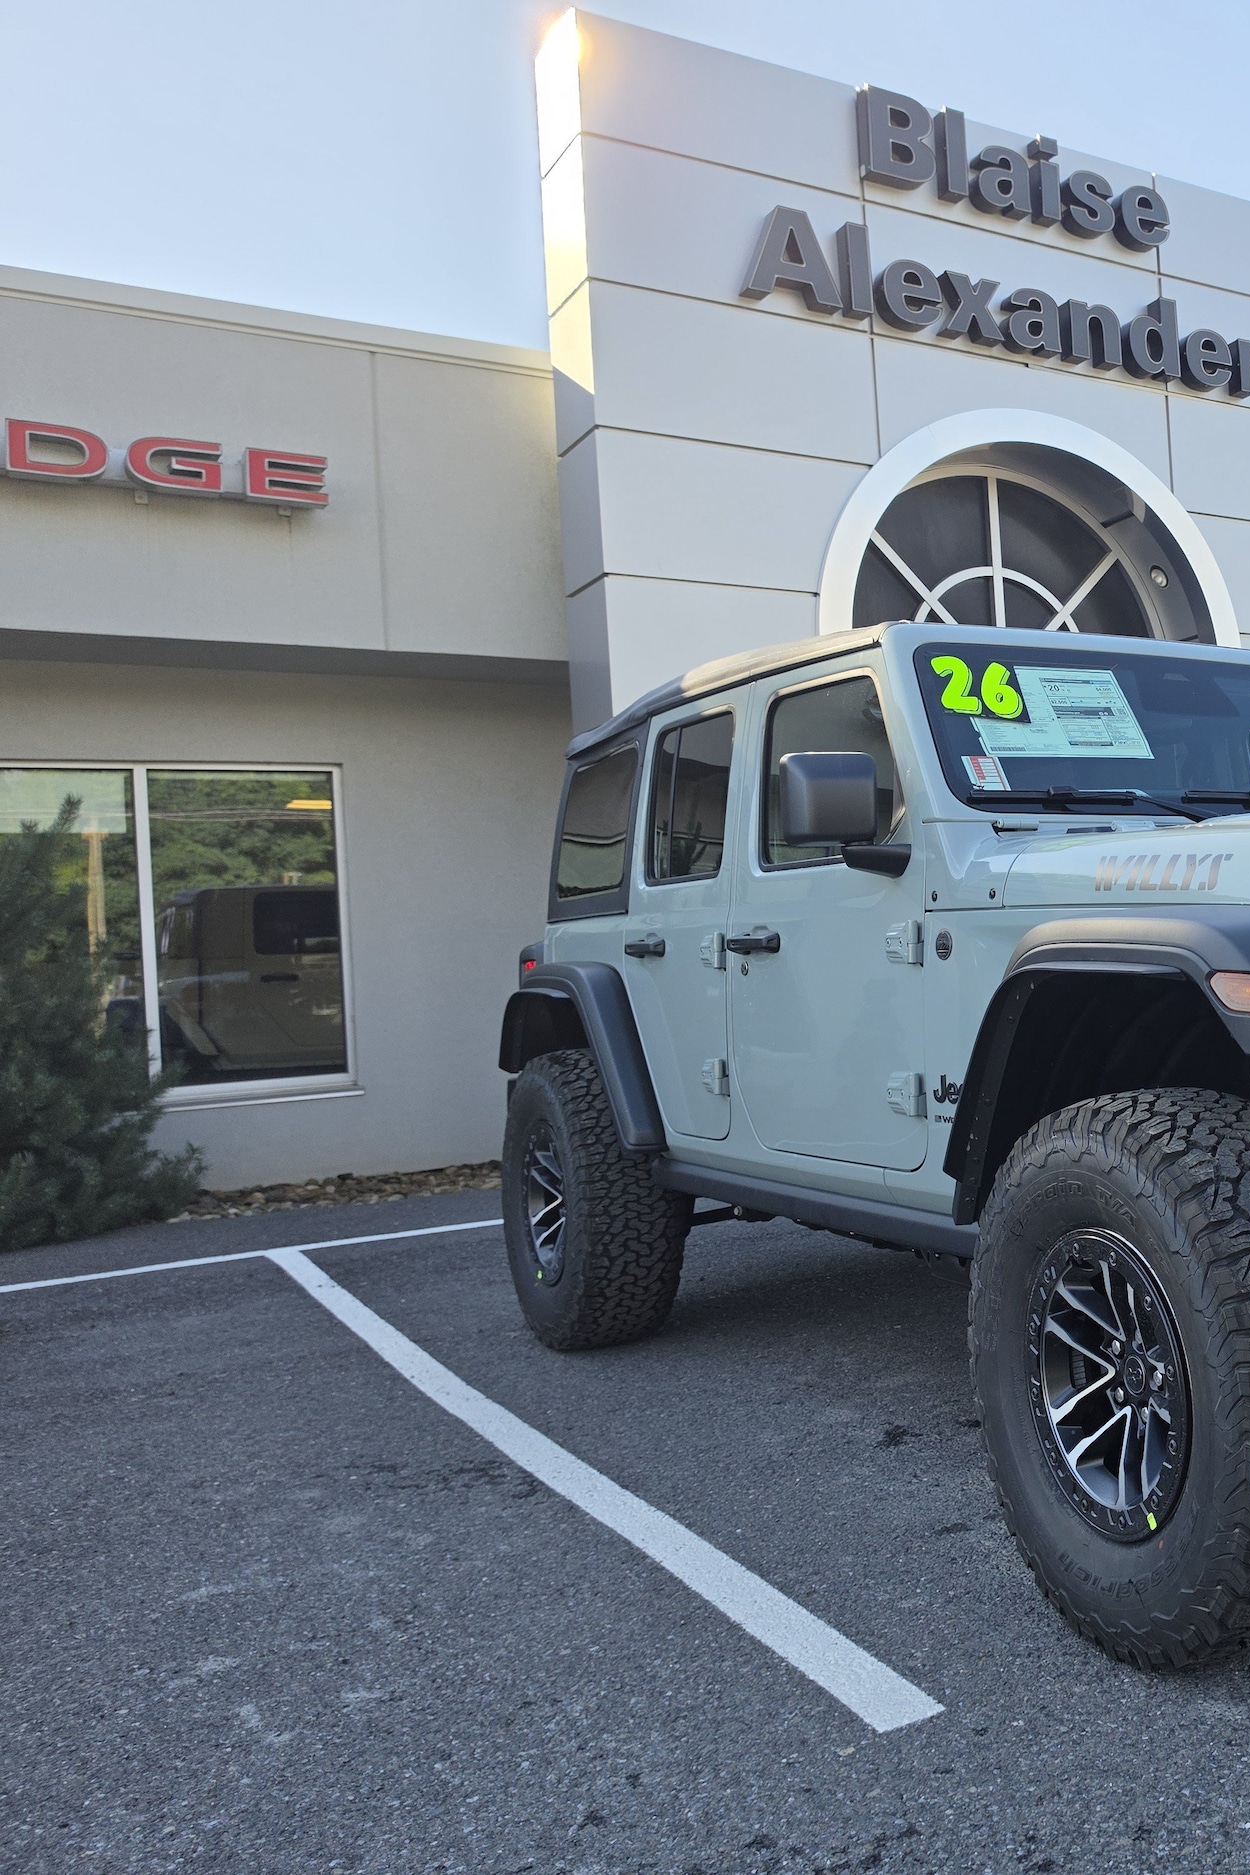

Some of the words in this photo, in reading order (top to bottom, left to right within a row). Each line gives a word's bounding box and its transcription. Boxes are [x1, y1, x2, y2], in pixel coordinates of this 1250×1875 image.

[855, 82, 1171, 252] Blaise
[930, 655, 1024, 719] 26
[1095, 853, 1234, 891] WILLYS
